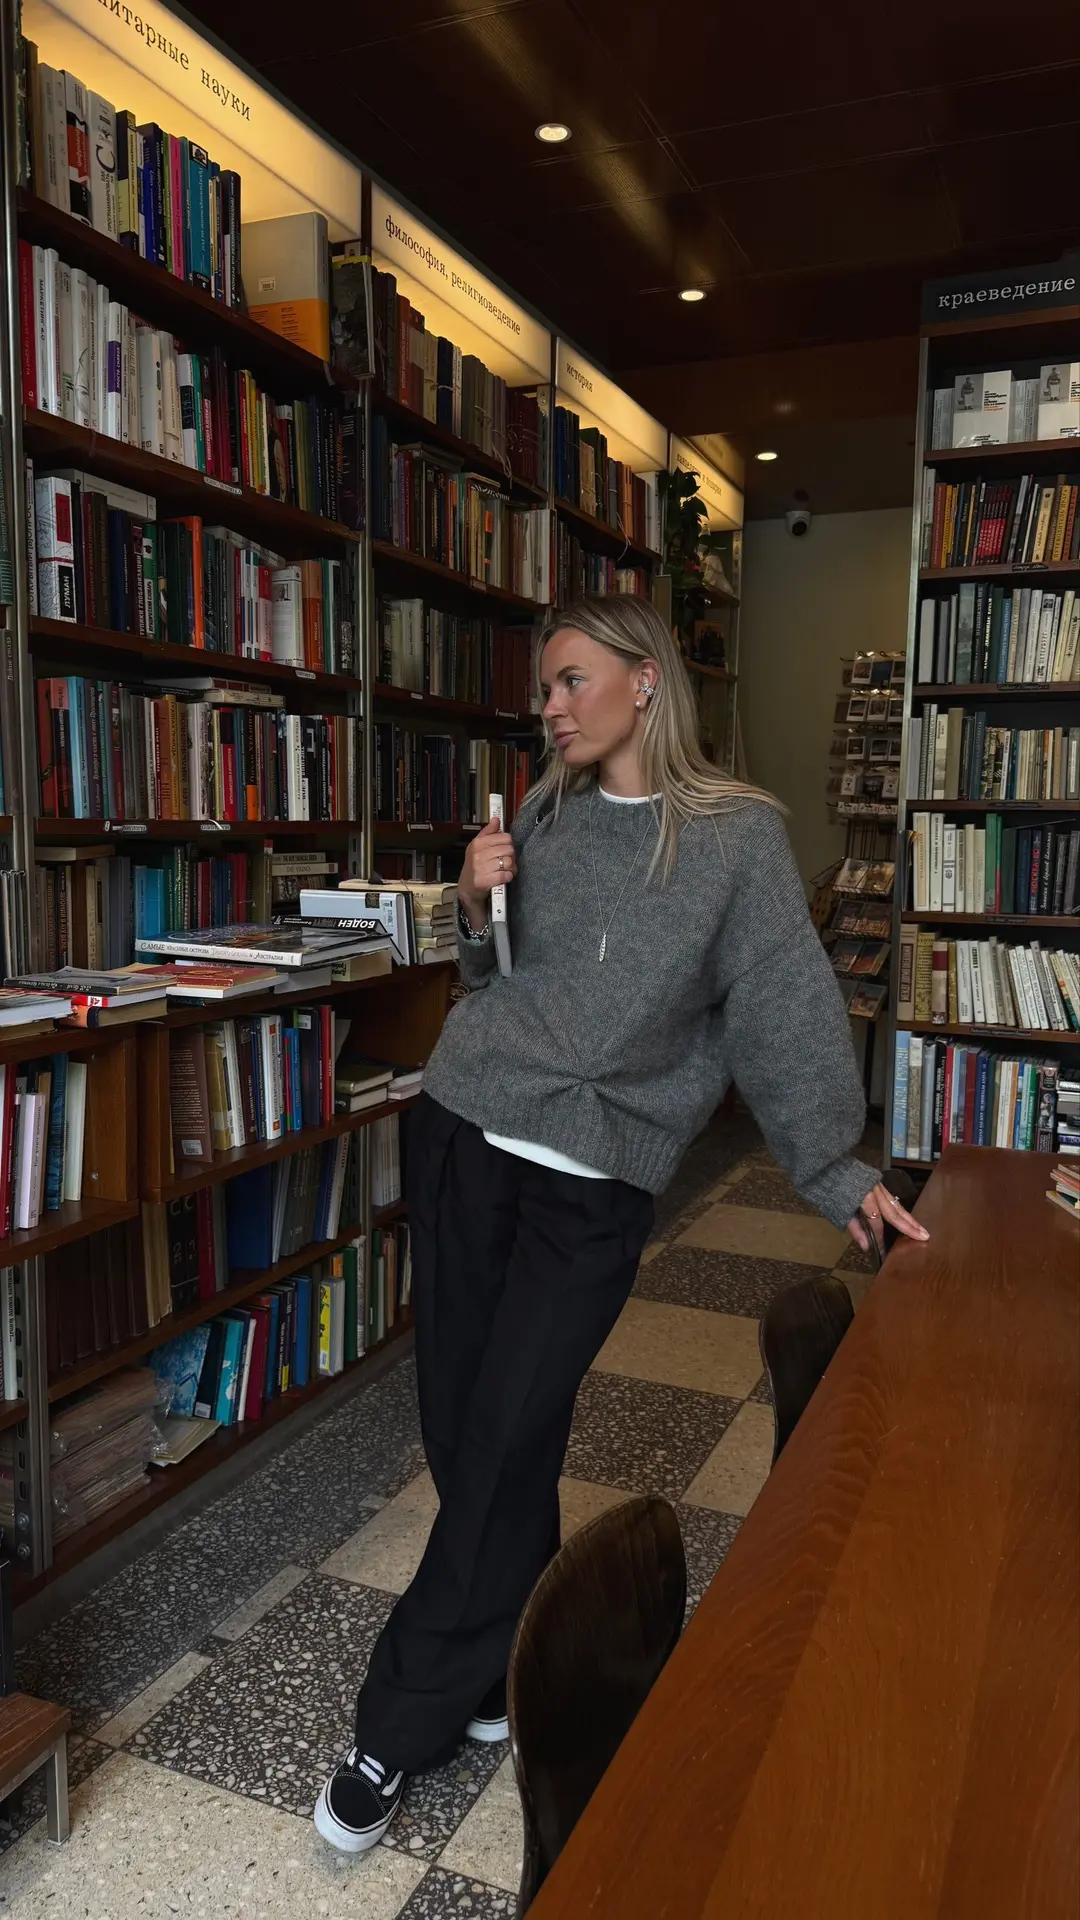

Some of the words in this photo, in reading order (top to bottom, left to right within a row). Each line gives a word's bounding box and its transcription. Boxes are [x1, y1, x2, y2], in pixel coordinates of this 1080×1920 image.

[201, 68, 250, 121] науки
[385, 214, 449, 280] философия,
[451, 271, 522, 335] религиоведение
[938, 276, 1075, 310] краеведение
[566, 362, 593, 393] история
[63, 575, 71, 608] ЛУМАН
[338, 919, 376, 929] БОДЕН
